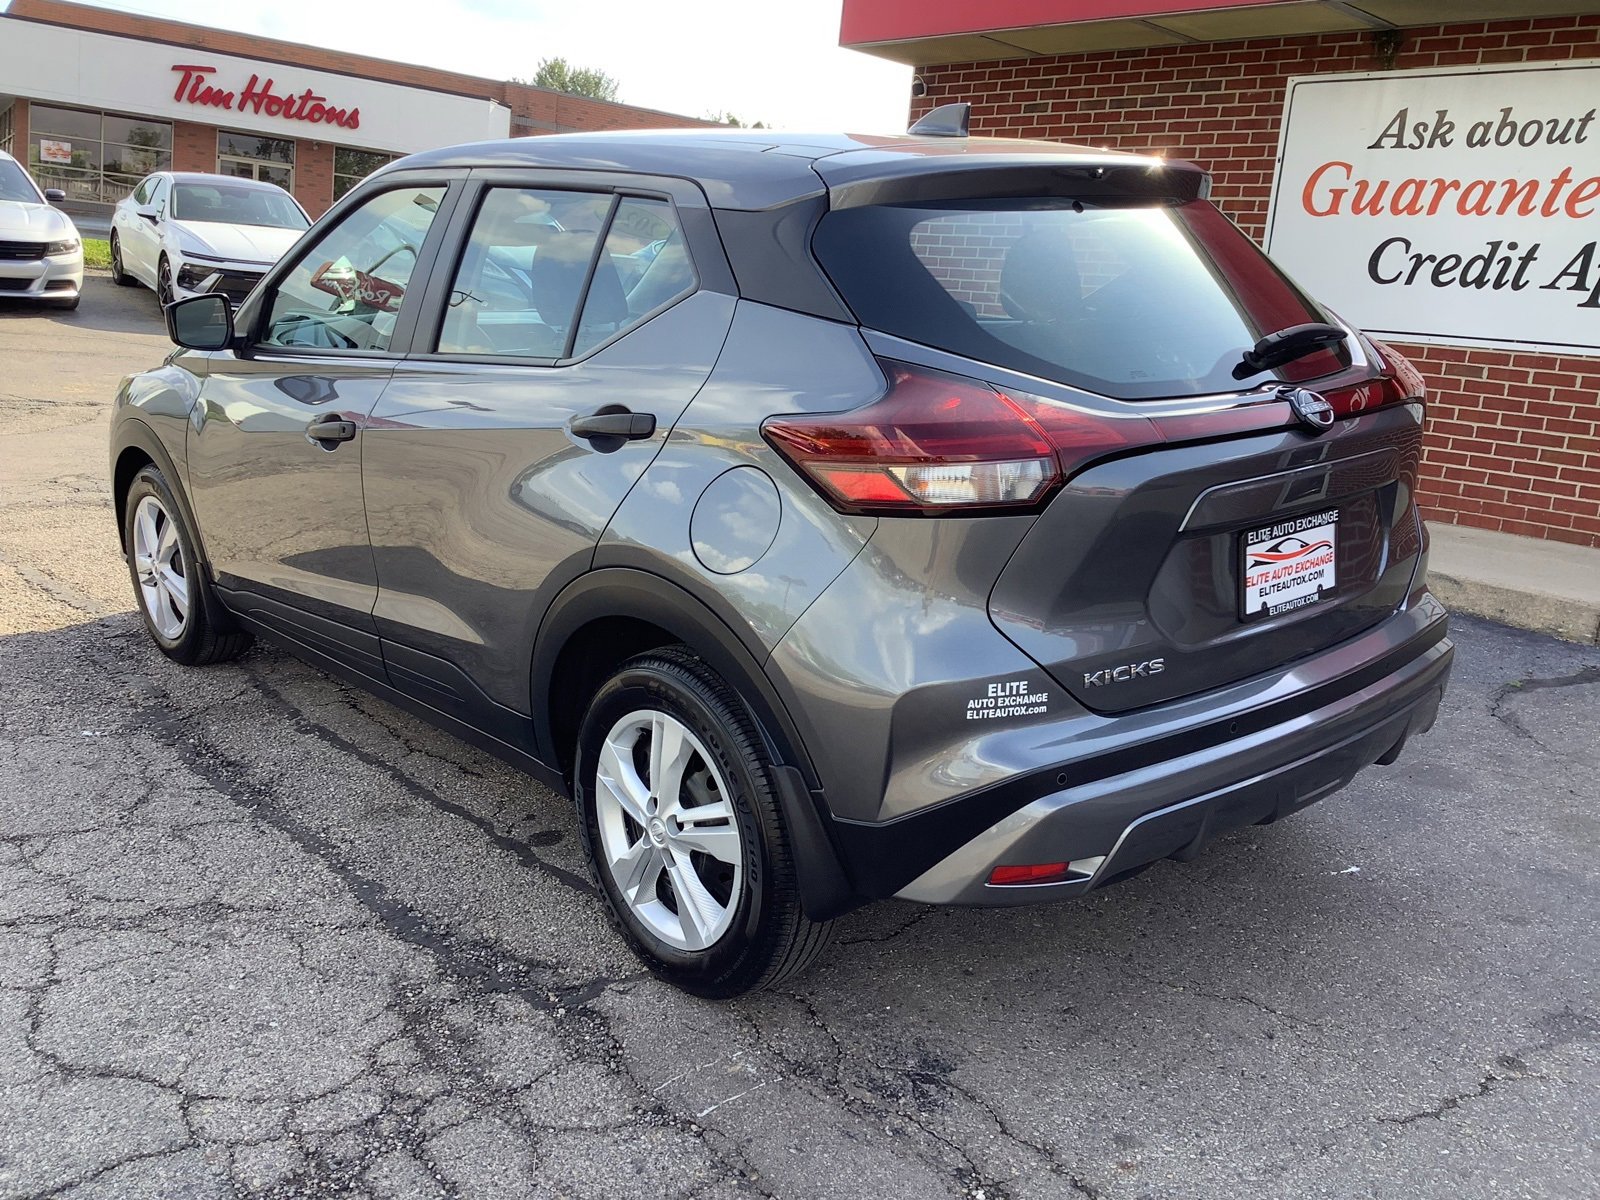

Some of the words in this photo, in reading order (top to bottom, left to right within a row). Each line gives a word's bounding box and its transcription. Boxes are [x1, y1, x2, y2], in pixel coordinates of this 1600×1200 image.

[171, 65, 234, 109] Tim
[237, 74, 360, 129] Hortons
[1366, 107, 1456, 150] Ask
[1465, 106, 1597, 148] about
[1301, 161, 1600, 219] Guarante
[1368, 236, 1541, 291] Credit
[1247, 527, 1272, 544] ELITE
[1272, 521, 1295, 538] AUTO
[1296, 509, 1339, 531] EXCHANGE
[1245, 571, 1271, 588] ELITE
[1271, 565, 1294, 581] AUTO
[1294, 552, 1334, 574] EXCHANGE
[1259, 569, 1325, 598] ELITEAUTOX.COM
[1269, 592, 1319, 616] ELITEAUTOX.COM
[987, 681, 1029, 697] ELITE
[1083, 657, 1165, 689] KICKS
[966, 704, 1048, 720] ELITEAUTOX.com
[967, 698, 996, 709] AUTO
[997, 692, 1049, 707] EXCHANGE
